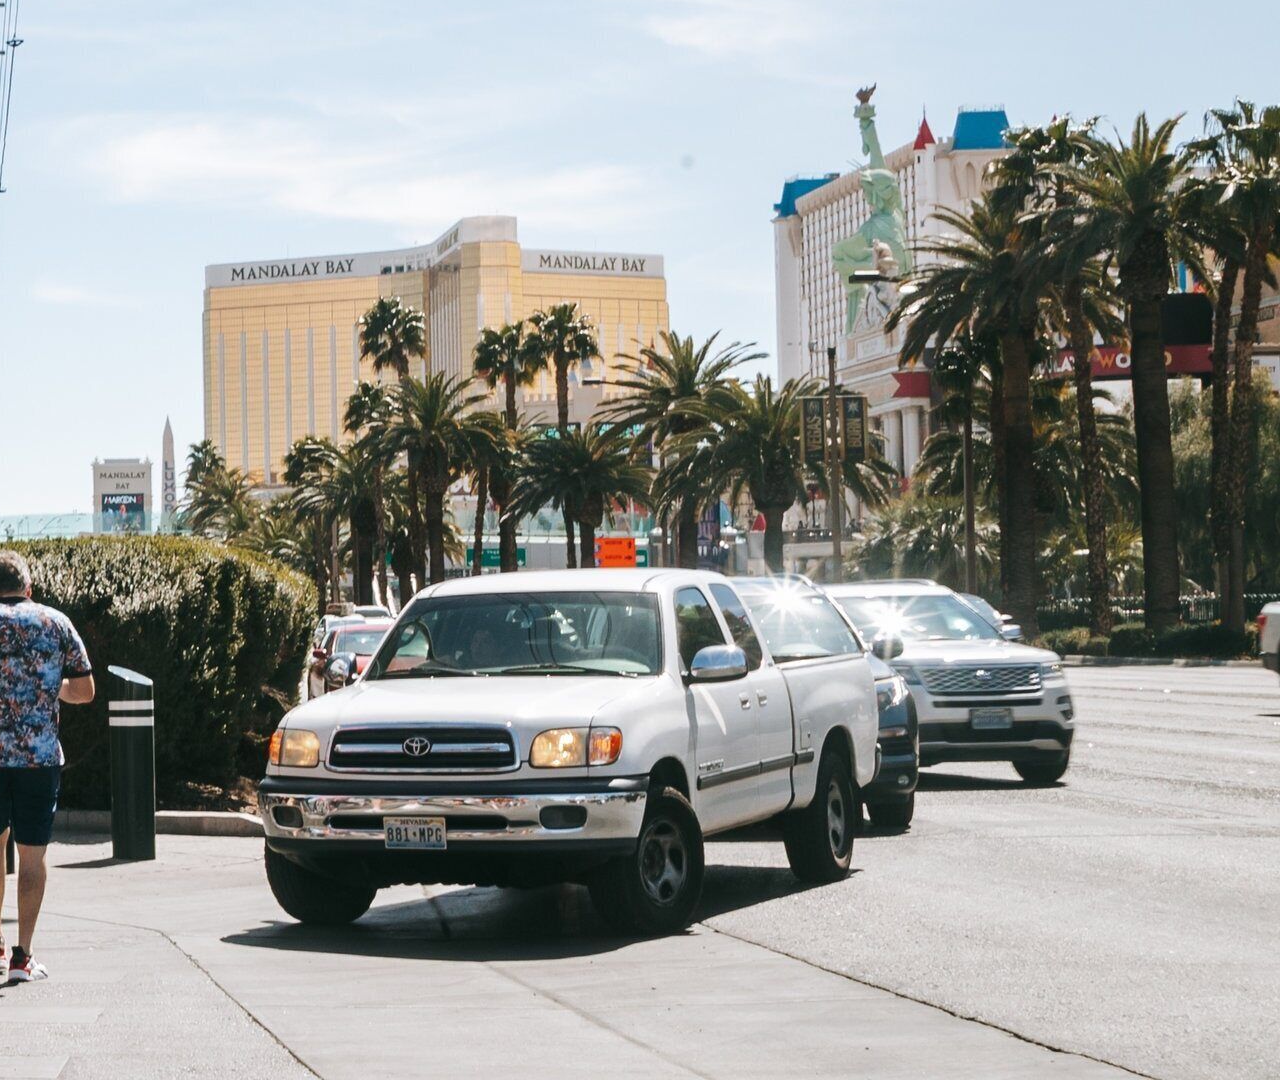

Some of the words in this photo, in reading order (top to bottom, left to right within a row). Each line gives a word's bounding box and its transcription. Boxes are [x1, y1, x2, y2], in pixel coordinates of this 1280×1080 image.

[231, 262, 319, 281] MANDALAY
[326, 259, 354, 274] BAY
[539, 255, 617, 271] MANDALAY
[621, 258, 646, 272] BAY
[99, 471, 146, 479] MANDALAY
[116, 482, 130, 490] BAY
[387, 827, 410, 842] 881
[418, 827, 442, 842] MPG
